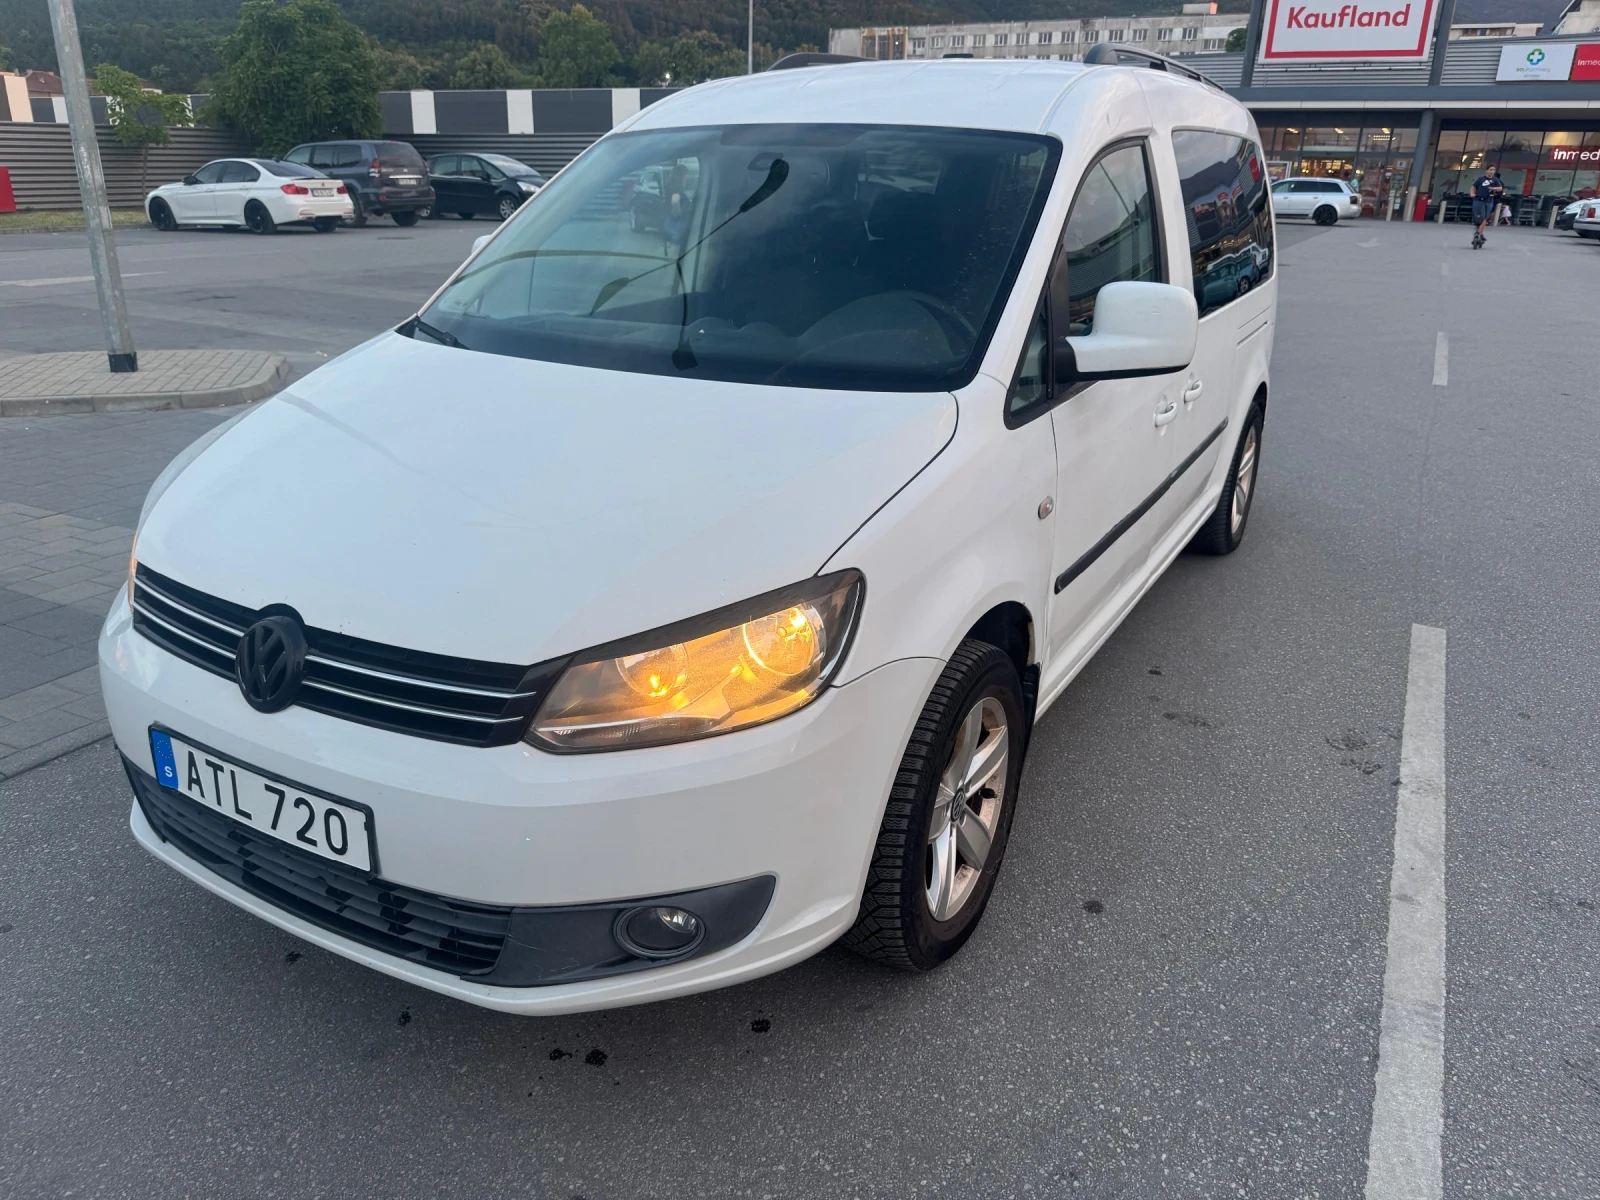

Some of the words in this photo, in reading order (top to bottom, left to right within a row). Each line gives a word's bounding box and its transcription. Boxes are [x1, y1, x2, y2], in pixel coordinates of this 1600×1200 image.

[1287, 4, 1411, 29] Kaufland
[164, 765, 173, 778] S
[187, 749, 253, 821] ATL
[264, 783, 349, 856] 720
